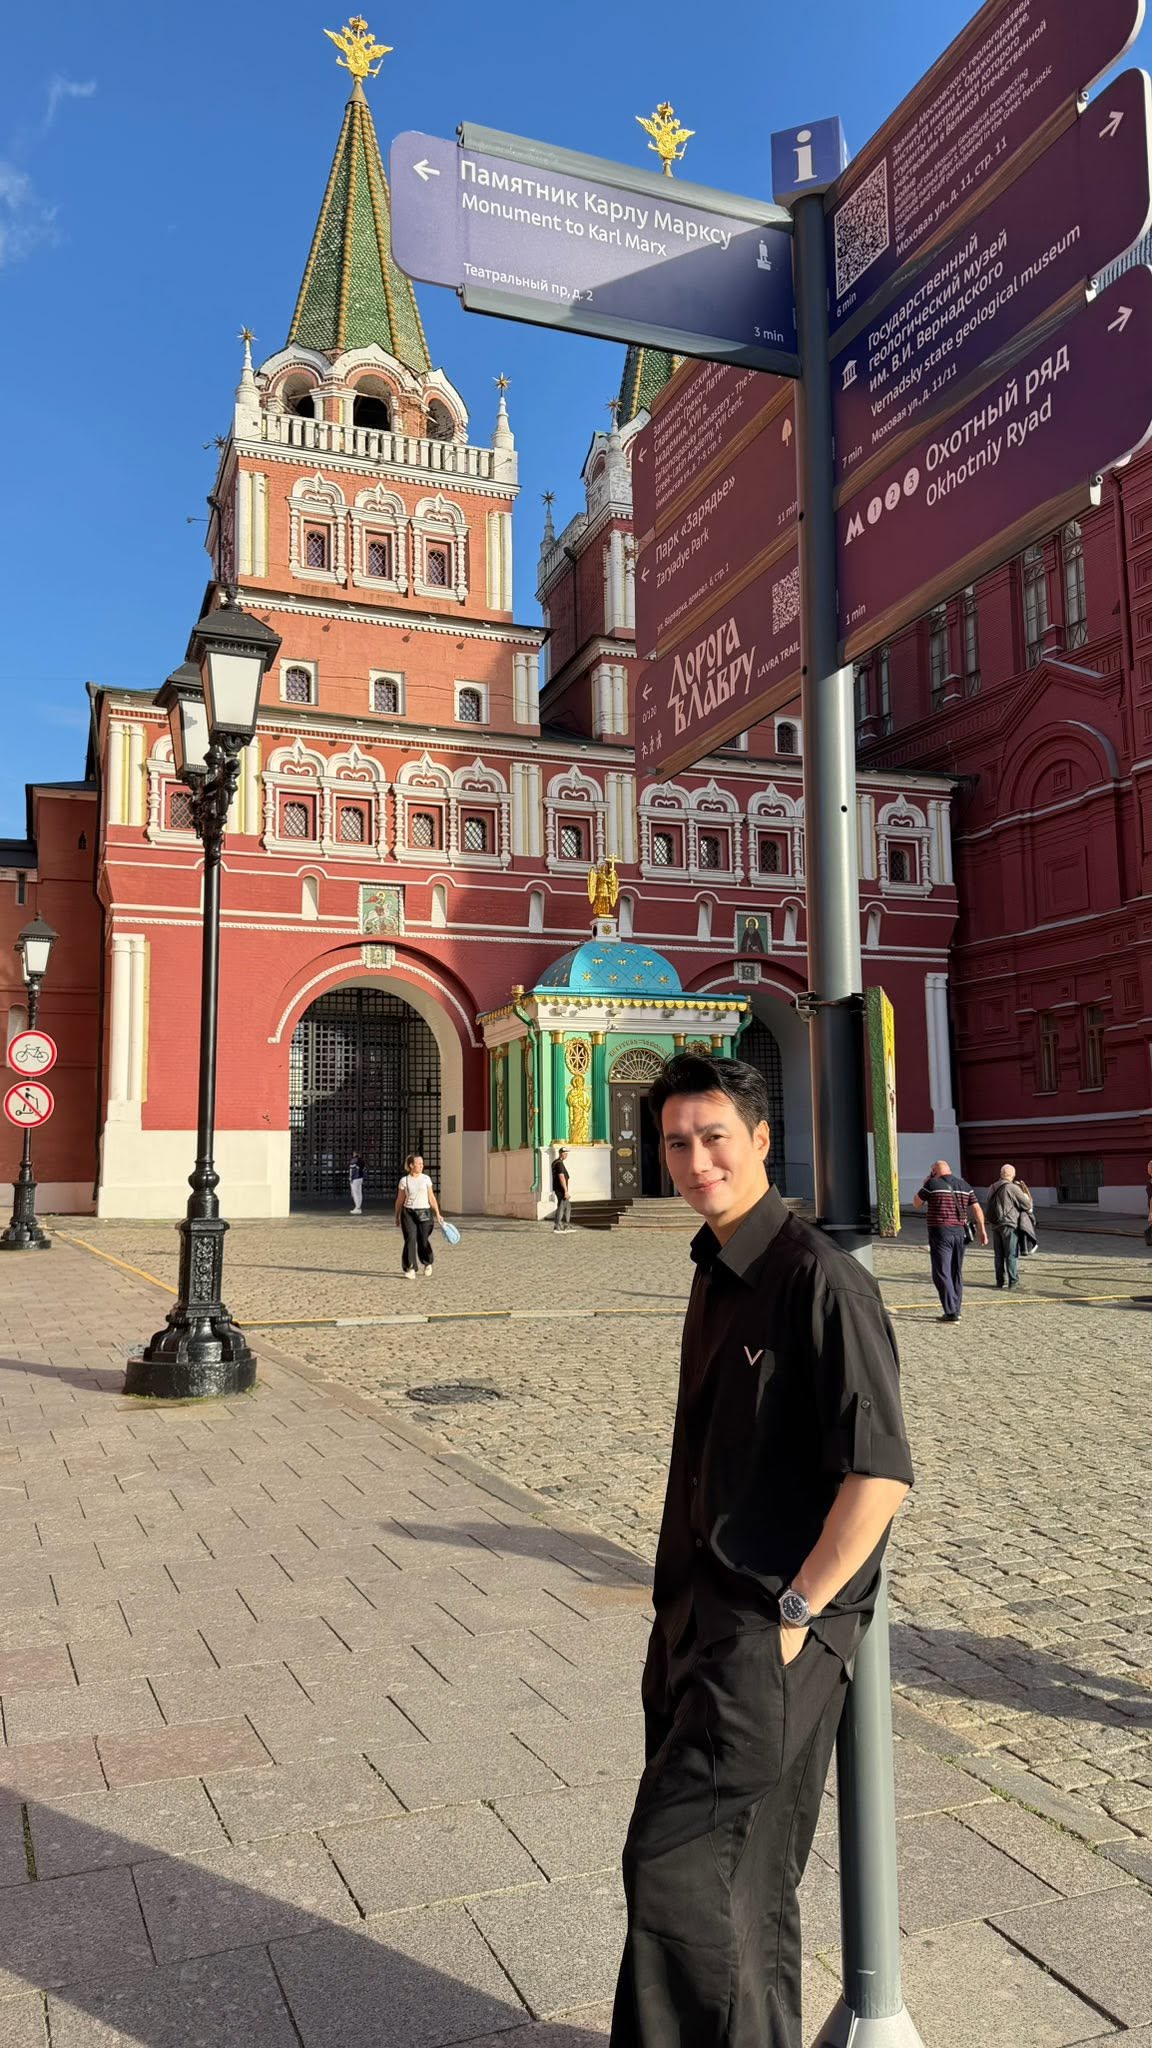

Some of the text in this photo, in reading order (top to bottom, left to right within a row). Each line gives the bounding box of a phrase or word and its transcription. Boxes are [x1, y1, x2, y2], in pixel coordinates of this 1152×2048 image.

[893, 124, 929, 168] института
[930, 93, 955, 127] имени
[964, 12, 1029, 87] Орджоникидзе,
[893, 19, 1046, 196] участвовали в Великой Отечественной
[893, 139, 926, 180] студенты
[934, 80, 980, 135] сотрудники
[981, 36, 1019, 83] которого
[893, 123, 918, 157] Здание
[919, 67, 967, 126] Московского
[923, 169, 933, 183] the
[934, 144, 957, 172] Moscow
[958, 108, 989, 147] Geological
[990, 68, 1028, 112] Prospecting
[919, 173, 938, 199] named
[939, 158, 953, 177] after
[1004, 83, 1025, 107] which
[920, 191, 931, 208] and
[946, 136, 983, 182] participated
[991, 117, 1002, 133] the
[1003, 97, 1021, 120] Great
[1022, 65, 1052, 100] Patriotic
[461, 160, 731, 250] Памятник Карлу Марксу
[462, 192, 667, 256] Monument to Karl Marx
[894, 177, 916, 205] войне
[896, 136, 1007, 256] Моховая ул., д. 11, стр. 11
[463, 262, 548, 291] Театральный
[572, 289, 584, 301] д.
[586, 290, 593, 301] 2
[836, 292, 857, 318] 6 min
[869, 232, 978, 350] Государственный
[869, 229, 1007, 371] геологический музей
[870, 261, 1003, 392] им. В.И. Вернадского
[871, 225, 1080, 417] Vernadsky state geological museum
[754, 326, 784, 342] 3 min
[653, 362, 711, 438] Заиконоспасский
[655, 432, 696, 484] Zaikonospassky
[697, 395, 730, 436] monastery
[735, 376, 748, 394] The
[872, 363, 957, 444] Моховая ул., д. 11/11
[926, 345, 1070, 471] Охотный ряд
[654, 425, 688, 469] Академия,
[655, 457, 687, 496] Greek-Latin
[687, 427, 714, 462] Academy,
[727, 396, 744, 418] cent.
[842, 445, 863, 469] 7 min
[926, 393, 1051, 506] Okhotniy Ryad
[656, 476, 683, 510] Никольская
[656, 476, 735, 564] Парк «Зарядье»
[778, 500, 799, 525] 11 min
[656, 527, 709, 588] Zaryadye Park
[757, 640, 800, 678] LAVRA TRAIL
[846, 604, 866, 626] 1 min
